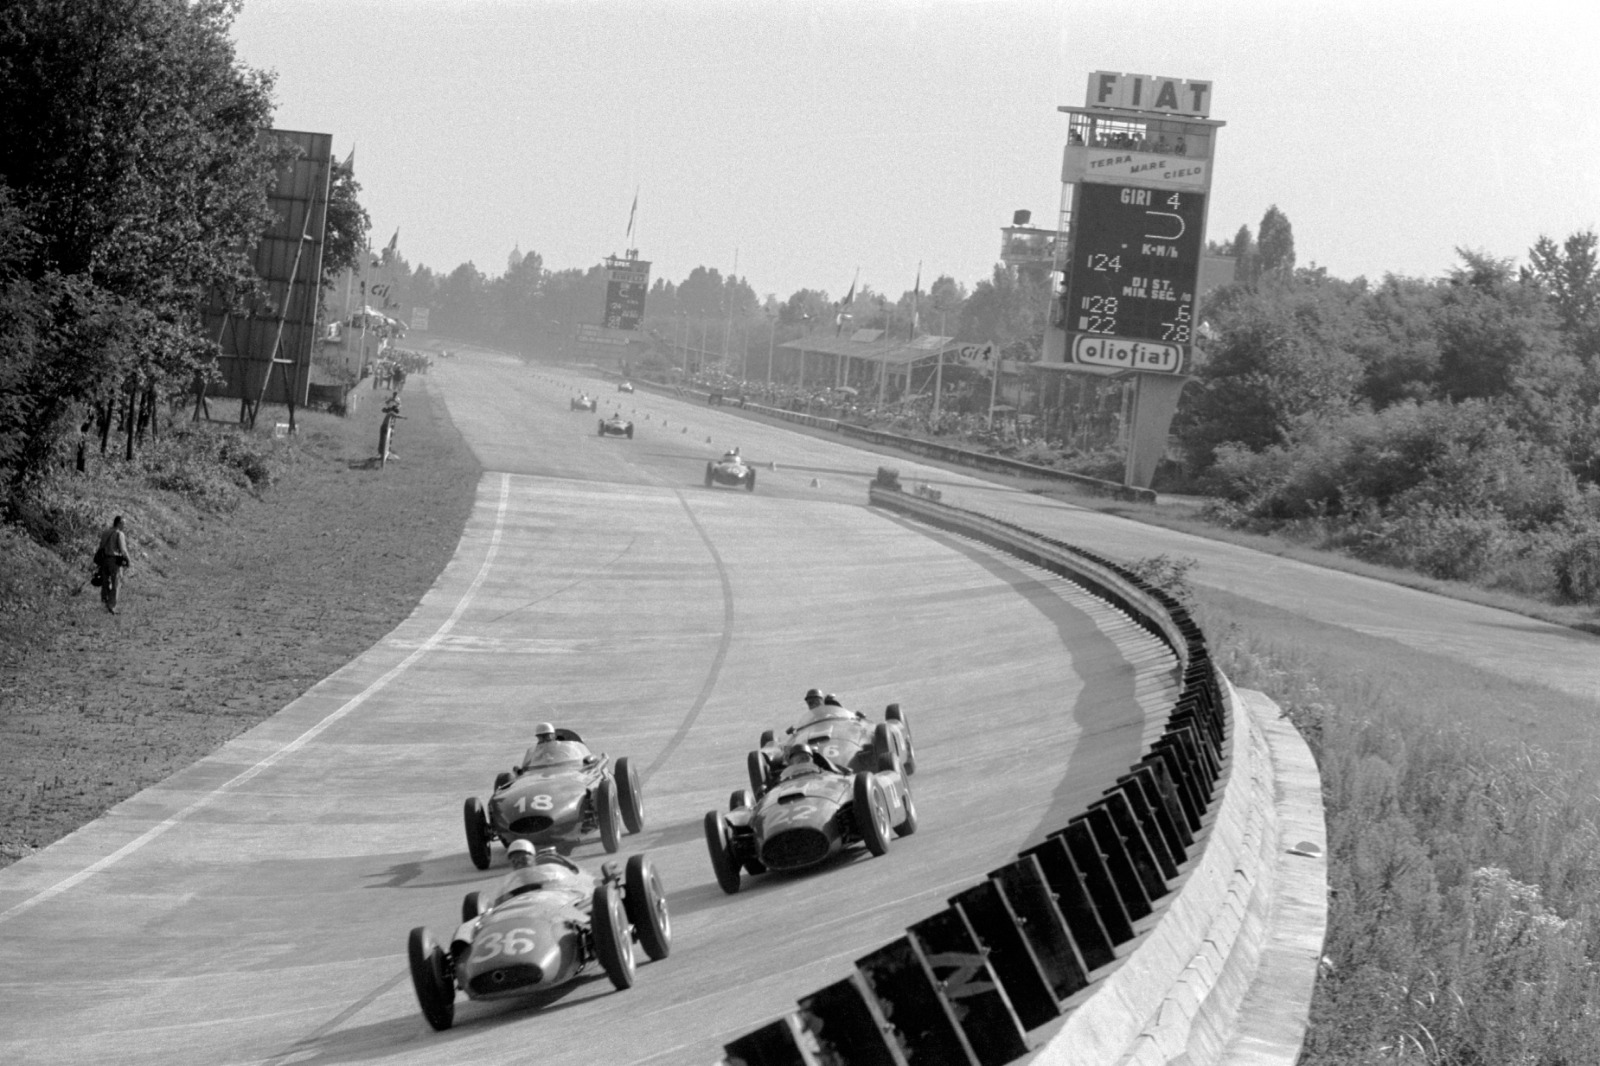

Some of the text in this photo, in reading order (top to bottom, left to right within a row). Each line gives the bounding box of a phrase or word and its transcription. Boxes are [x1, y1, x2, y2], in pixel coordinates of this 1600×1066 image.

[1097, 74, 1208, 112] FIAT
[1090, 155, 1133, 169] TERRA
[1130, 160, 1167, 174] MARE
[1163, 167, 1202, 179] CIELO
[1120, 188, 1181, 210] GIRI 4
[1085, 339, 1171, 367] oliofiat
[513, 794, 554, 814] 18
[767, 804, 818, 827] 22
[470, 927, 536, 964] 36
